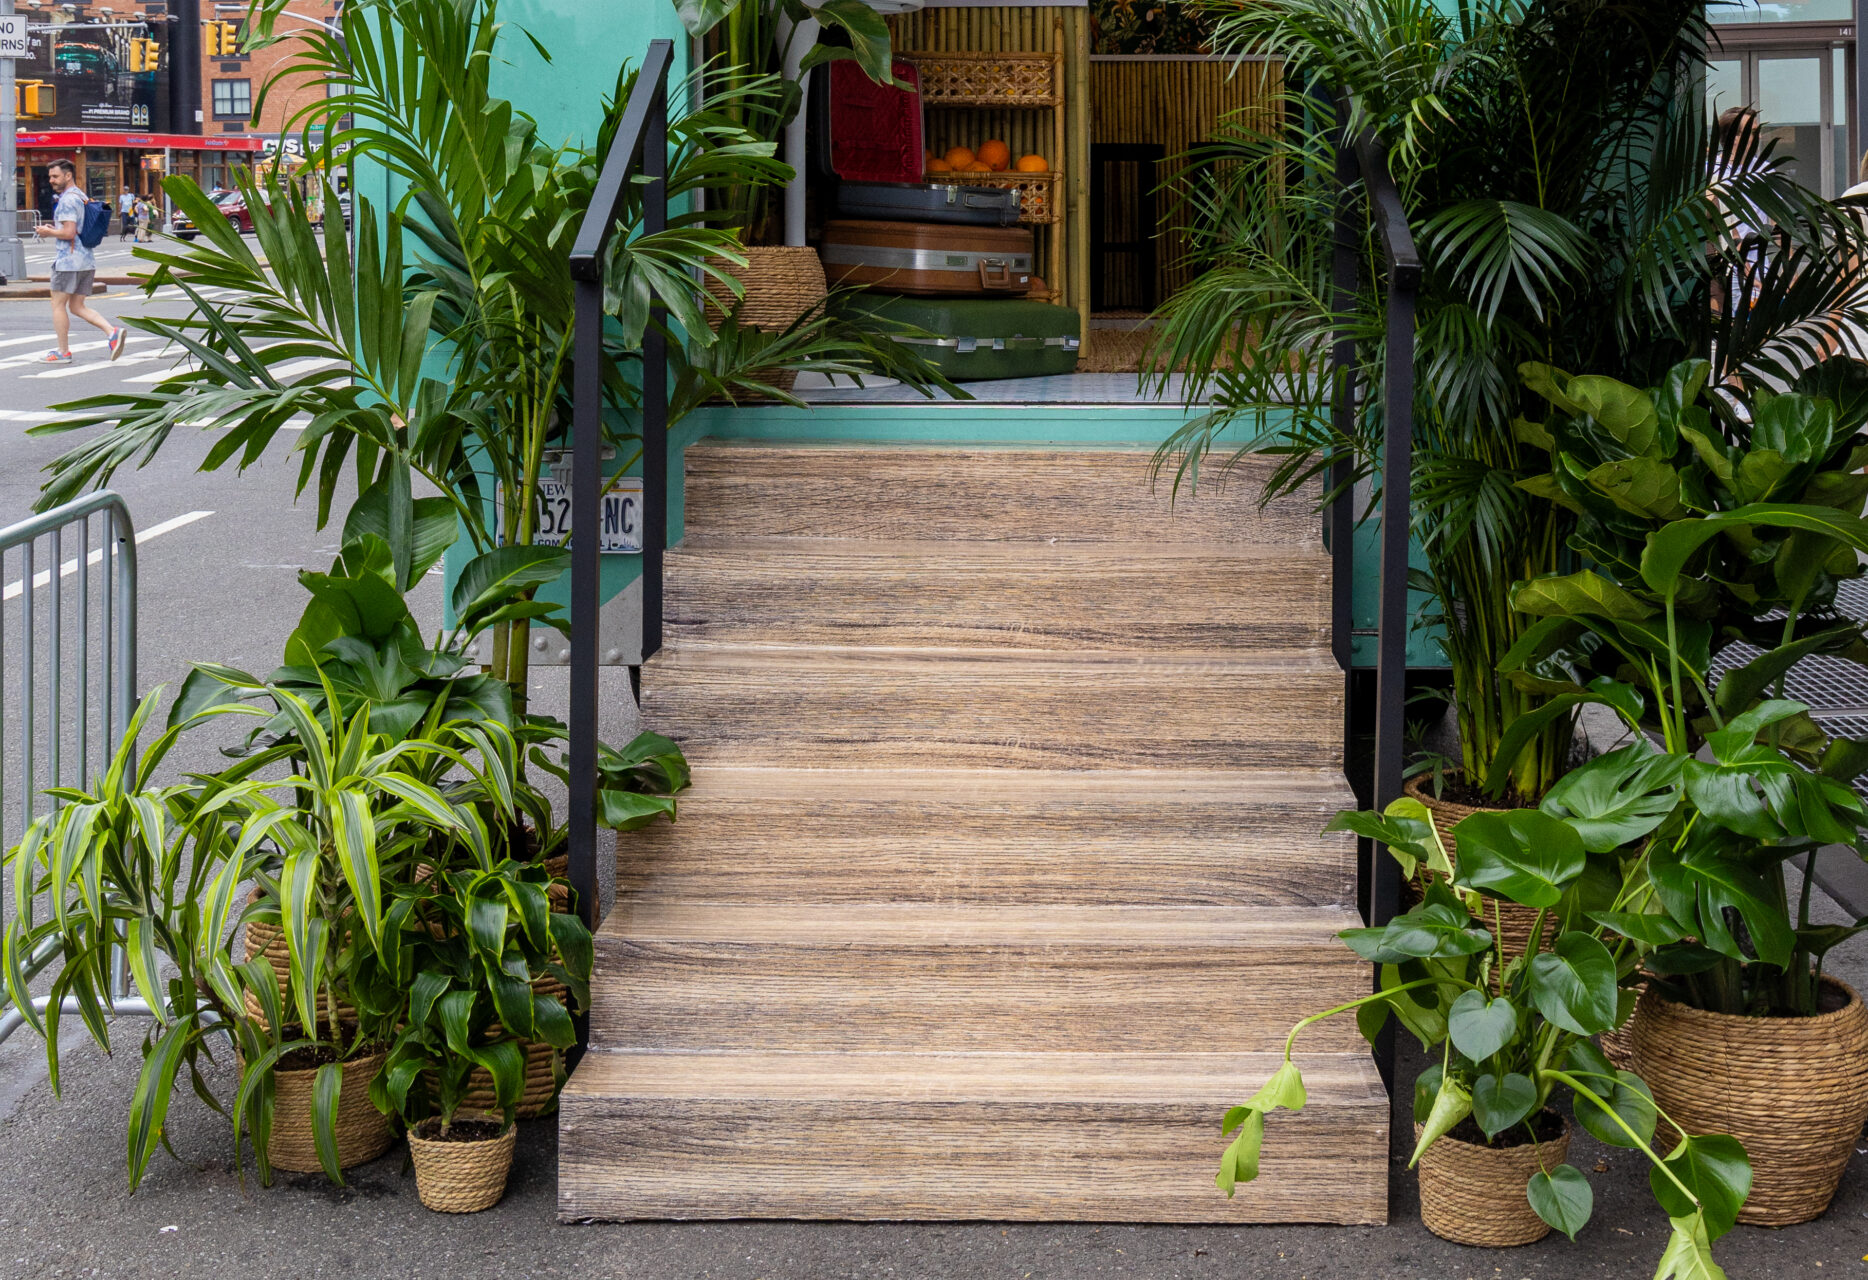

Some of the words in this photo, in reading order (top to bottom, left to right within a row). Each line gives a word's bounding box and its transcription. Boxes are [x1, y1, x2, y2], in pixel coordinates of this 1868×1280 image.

[0, 22, 14, 34] NO
[1839, 28, 1852, 36] 141
[1, 39, 24, 51] RNS
[262, 138, 299, 156] CVS
